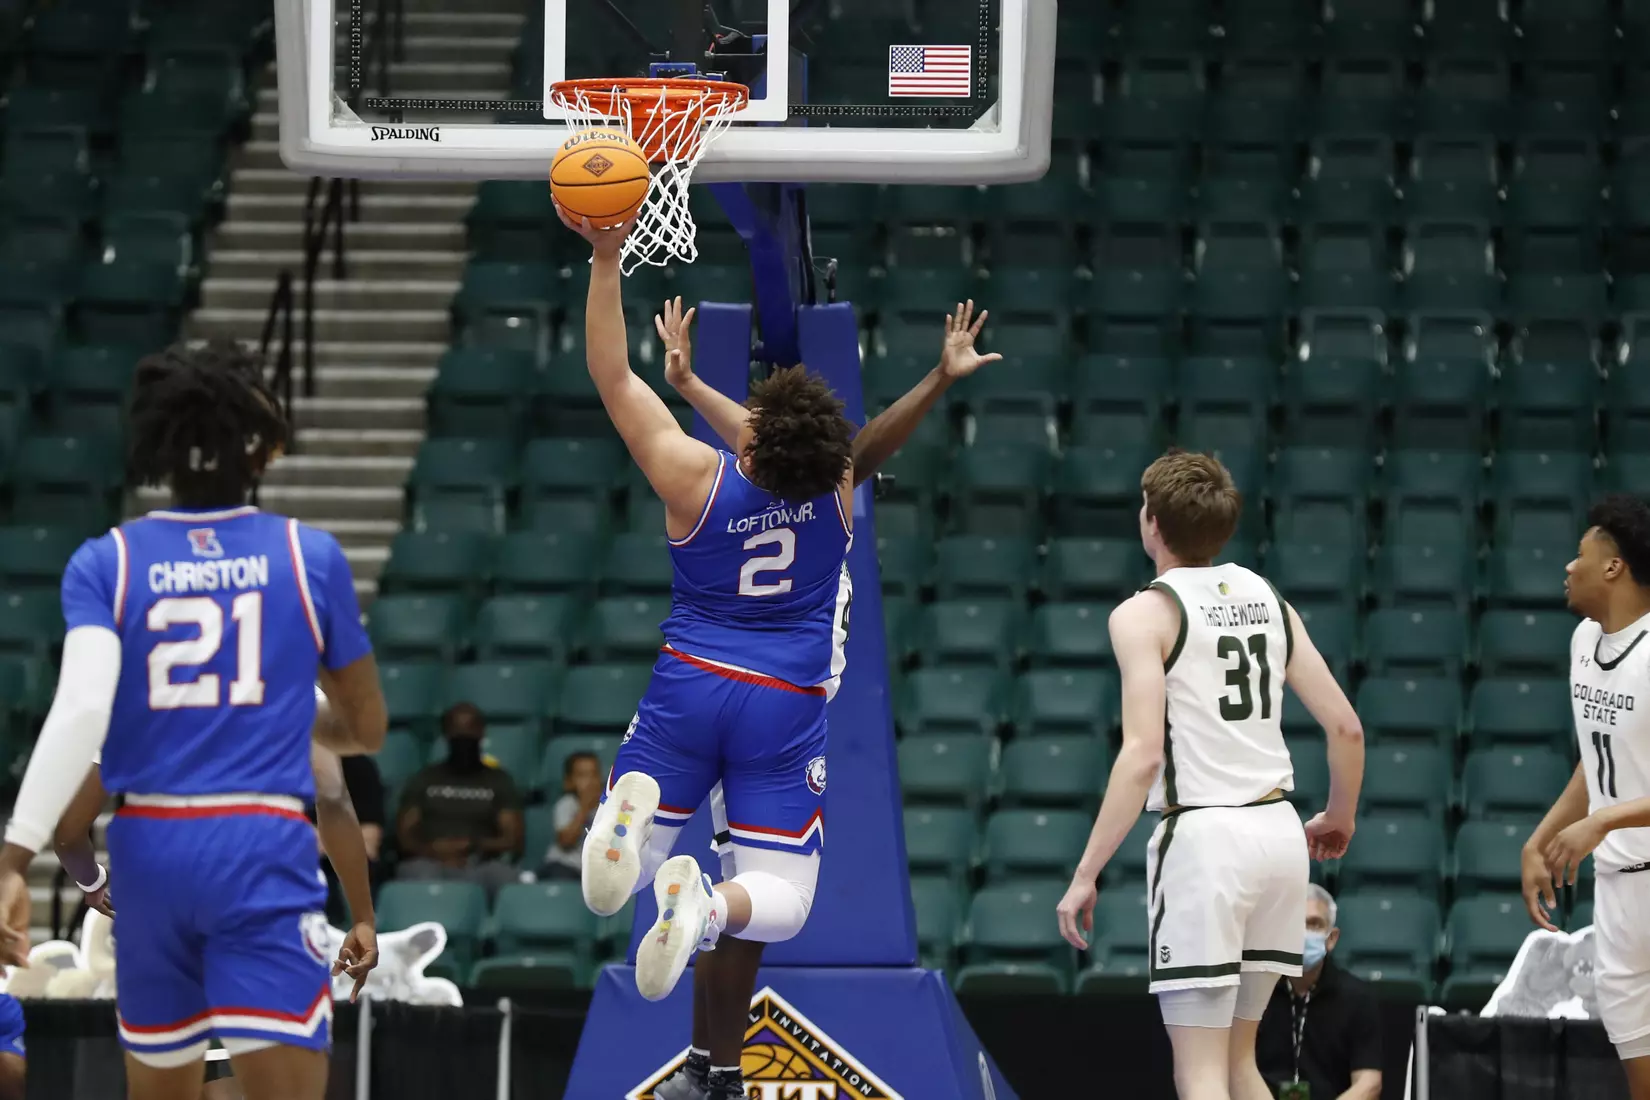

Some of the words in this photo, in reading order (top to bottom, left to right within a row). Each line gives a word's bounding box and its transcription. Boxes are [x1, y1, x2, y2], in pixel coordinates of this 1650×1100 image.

[371, 126, 440, 142] SPALDING
[564, 131, 630, 150] Wilson
[727, 508, 792, 533] LOFTON
[793, 502, 817, 523] JR.
[148, 554, 269, 593] CHRISTON
[737, 527, 796, 596] 2
[1199, 603, 1270, 627] THISTLEWOOD
[146, 591, 266, 711] 21
[1217, 633, 1272, 721] 31
[1574, 683, 1635, 712] COLORADO
[1583, 704, 1617, 726] STATE
[1592, 731, 1618, 798] 11
